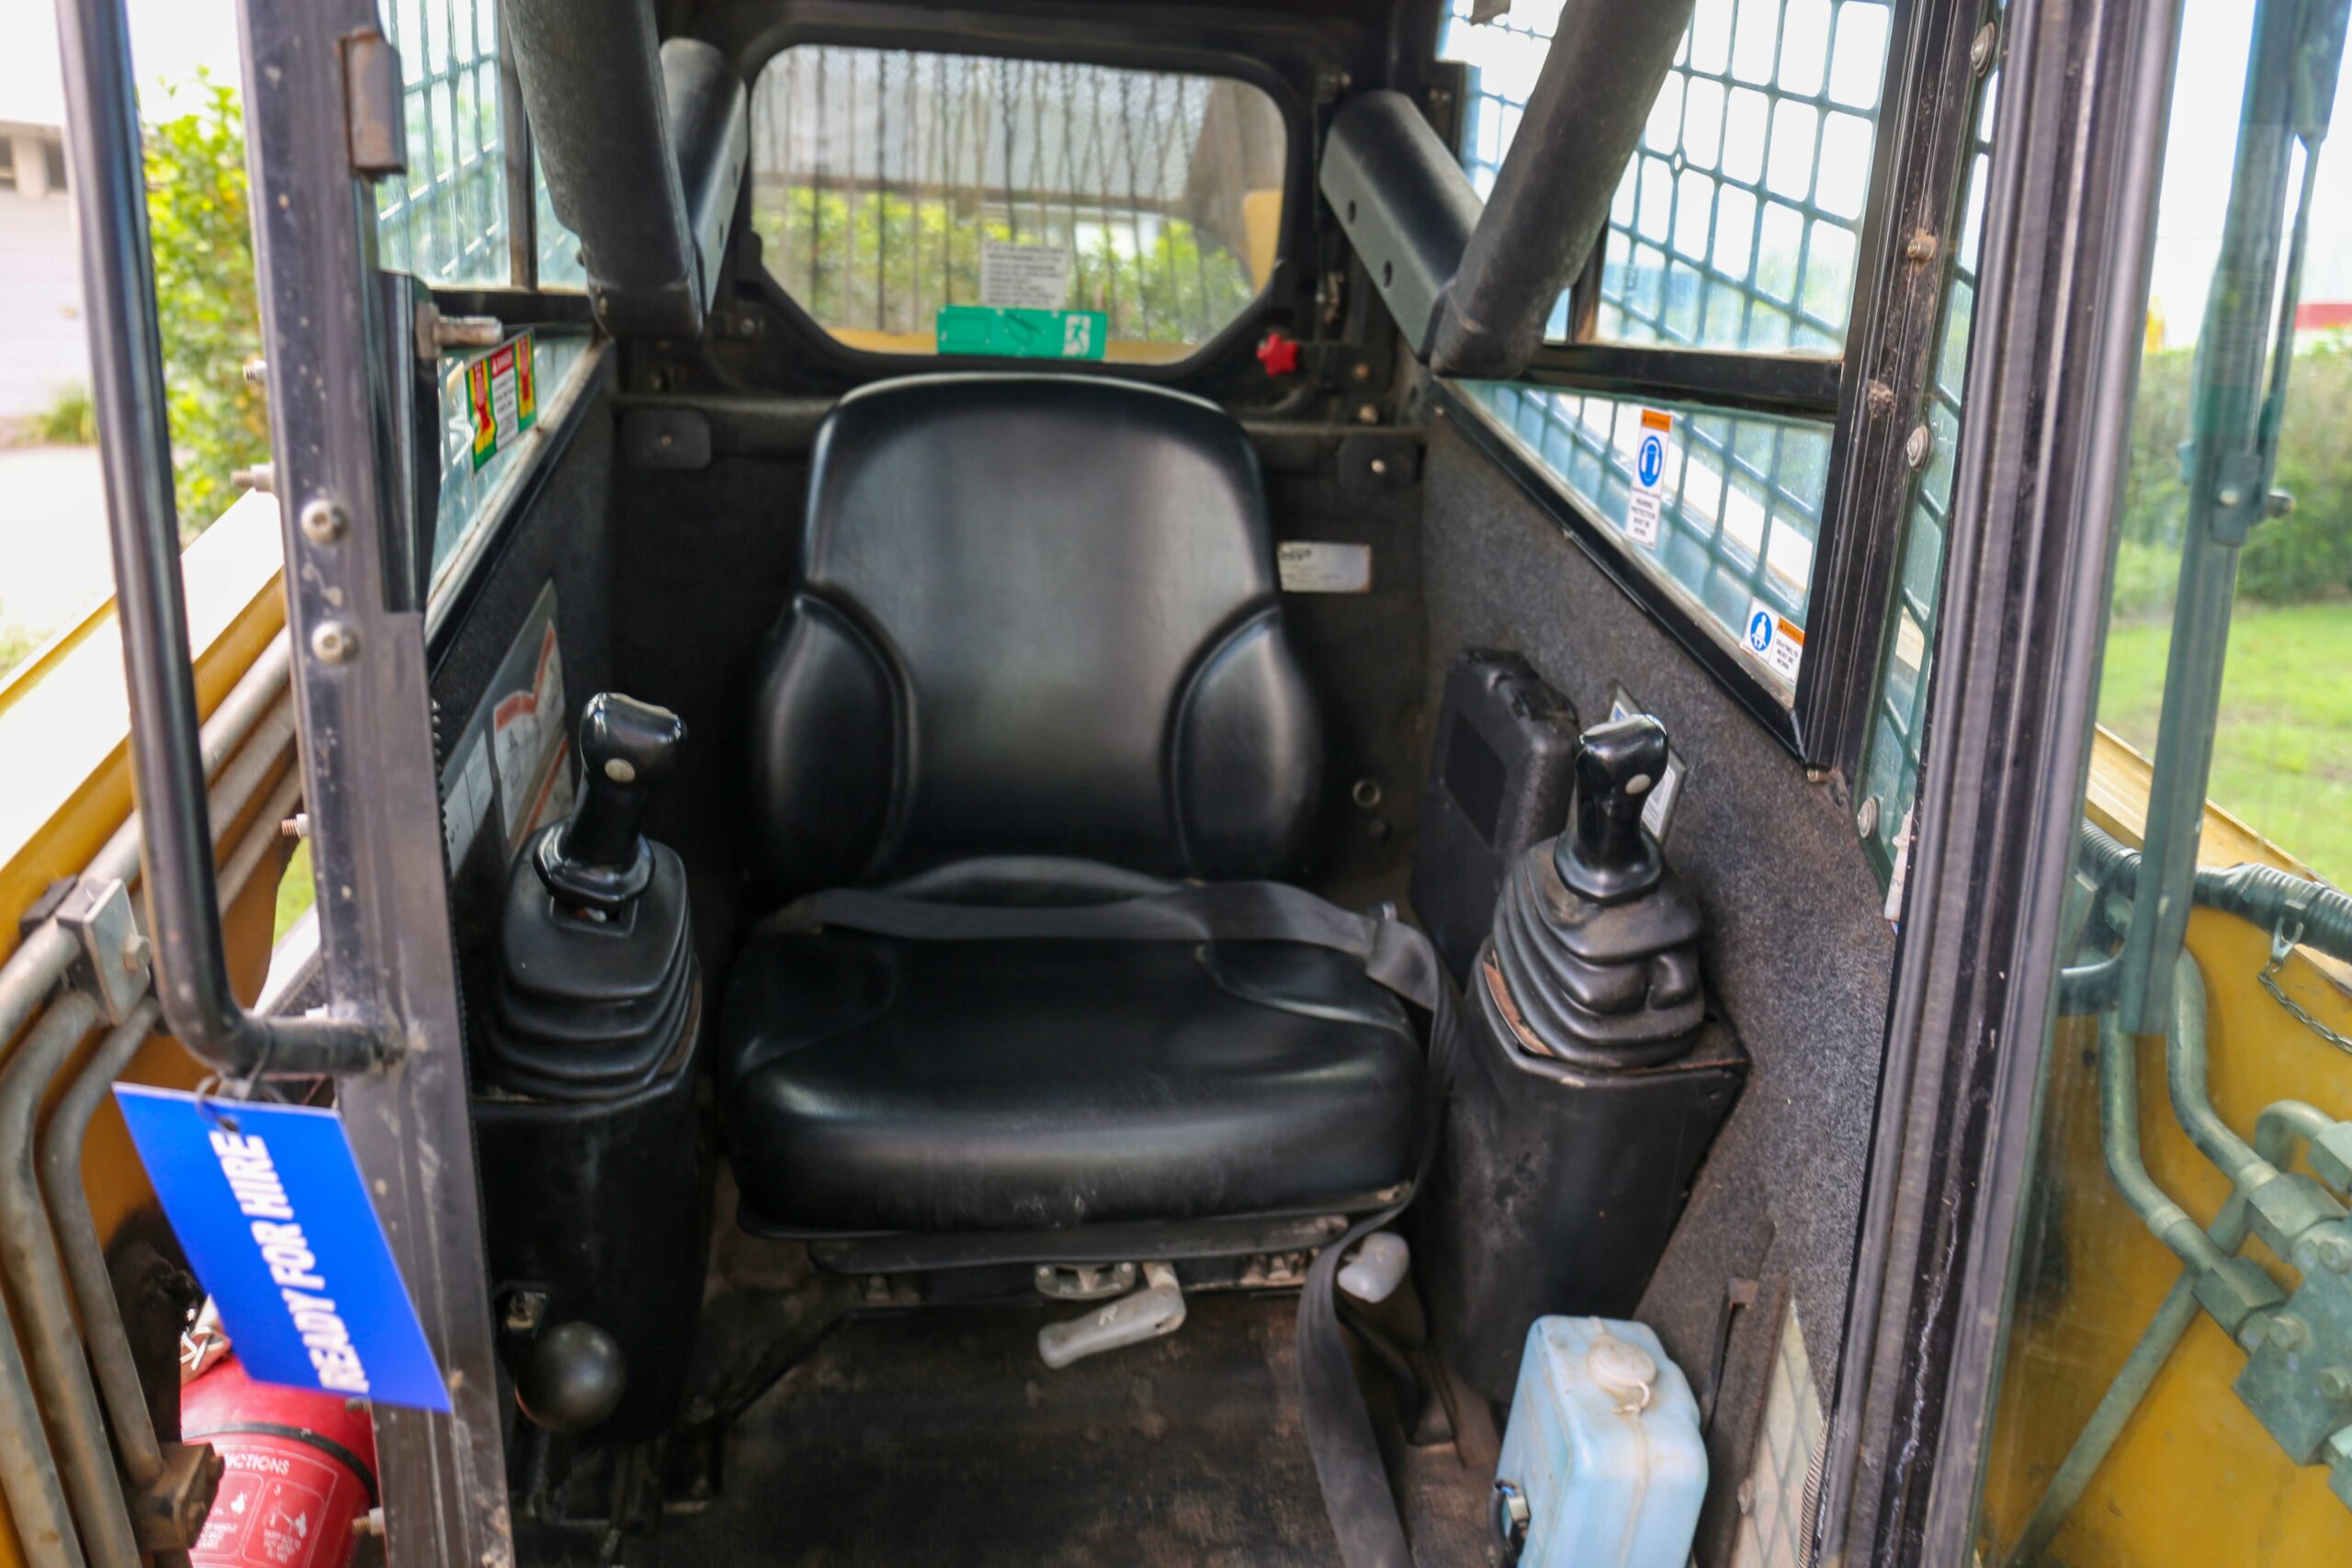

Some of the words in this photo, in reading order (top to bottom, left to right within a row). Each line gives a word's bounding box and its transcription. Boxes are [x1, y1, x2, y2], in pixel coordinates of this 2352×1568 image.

[208, 1129, 295, 1221] HIRE
[251, 1220, 325, 1291] FOR
[281, 1287, 370, 1394] READY
[224, 1452, 290, 1476] UCTIONS
